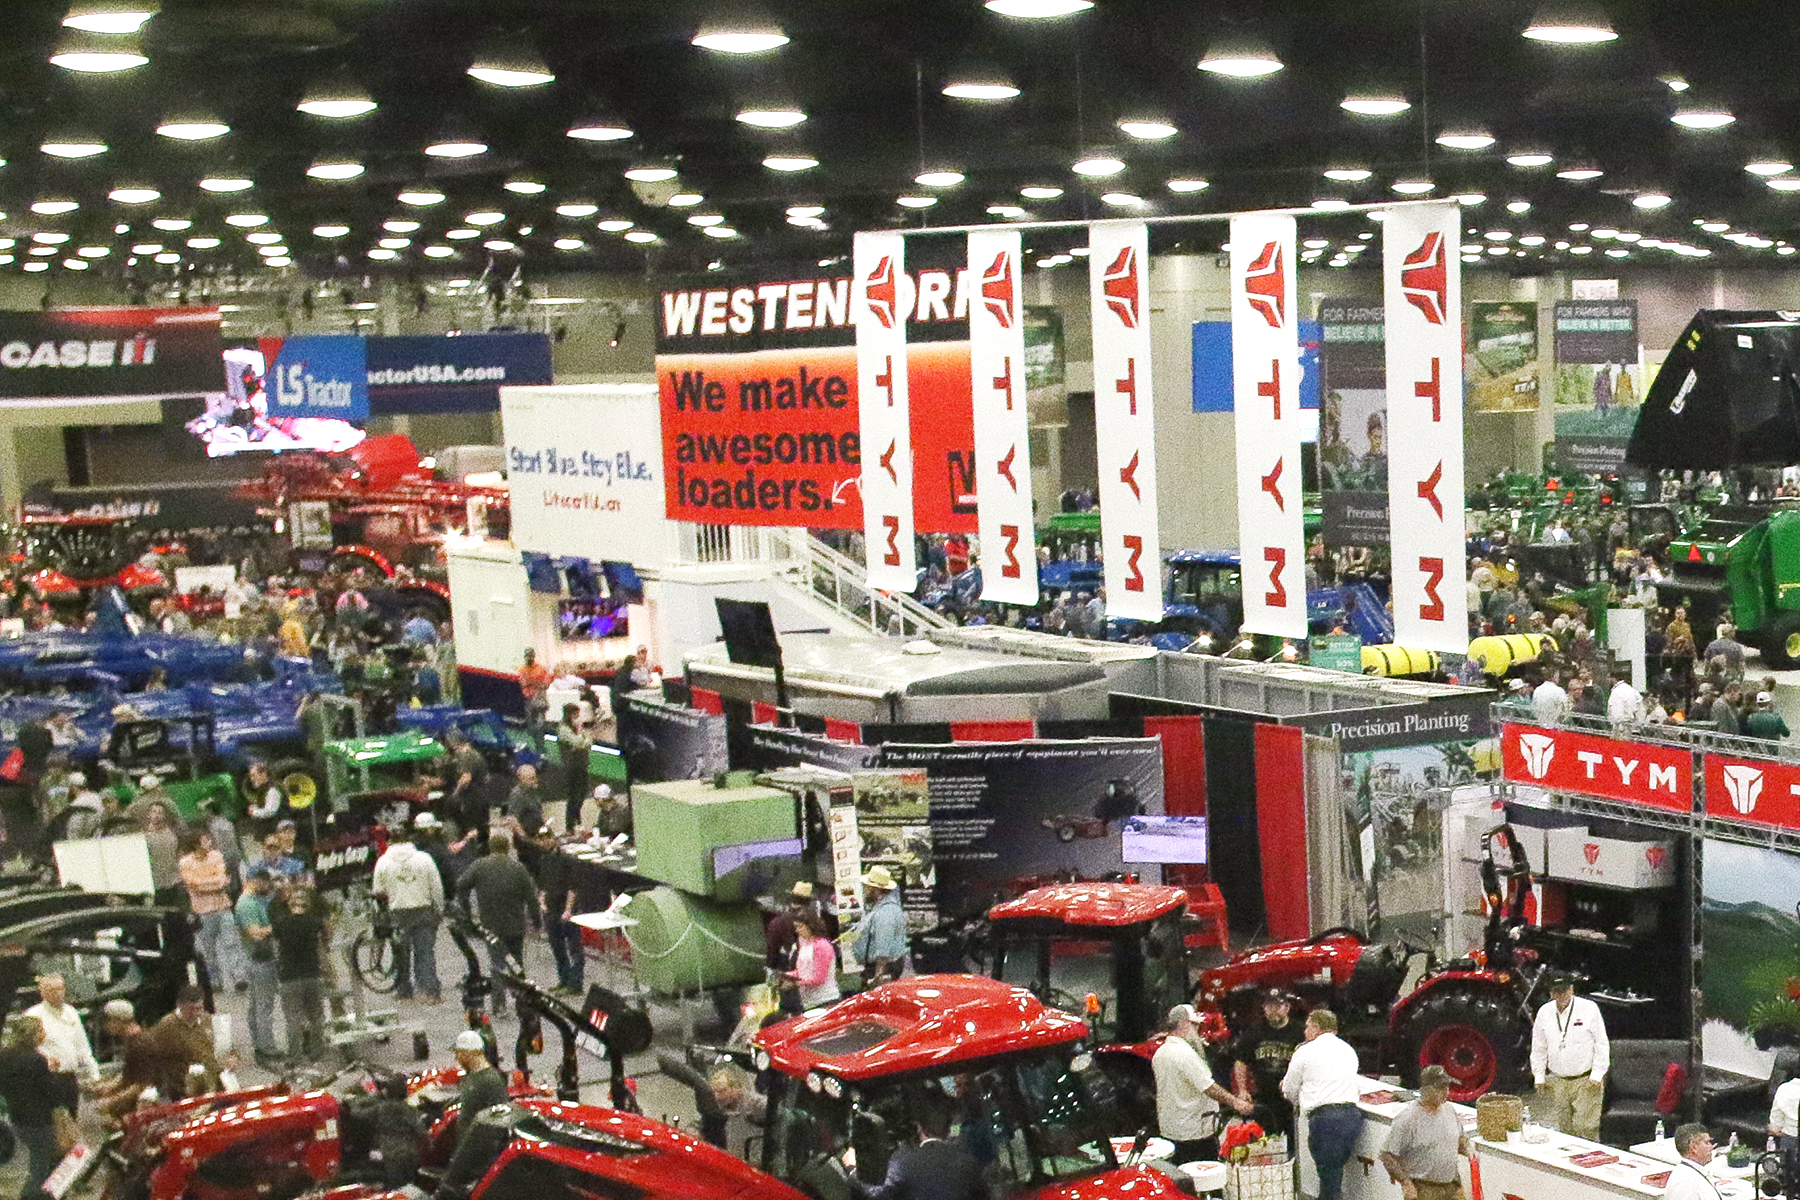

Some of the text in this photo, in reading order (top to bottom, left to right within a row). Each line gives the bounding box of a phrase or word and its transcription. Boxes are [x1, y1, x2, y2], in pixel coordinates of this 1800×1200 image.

[661, 271, 971, 337] WESTENR
[0, 340, 118, 368] CASE
[669, 366, 849, 412] We make
[675, 430, 862, 466] awesome
[876, 356, 900, 567] TYM
[994, 360, 1021, 579] TYM
[1116, 357, 1144, 592] TYM
[676, 468, 835, 512] loaders.
[1258, 359, 1287, 607] TYM
[1414, 356, 1445, 621] TYM
[1330, 711, 1470, 741] Precision Planting
[1577, 751, 1678, 794] TYM
